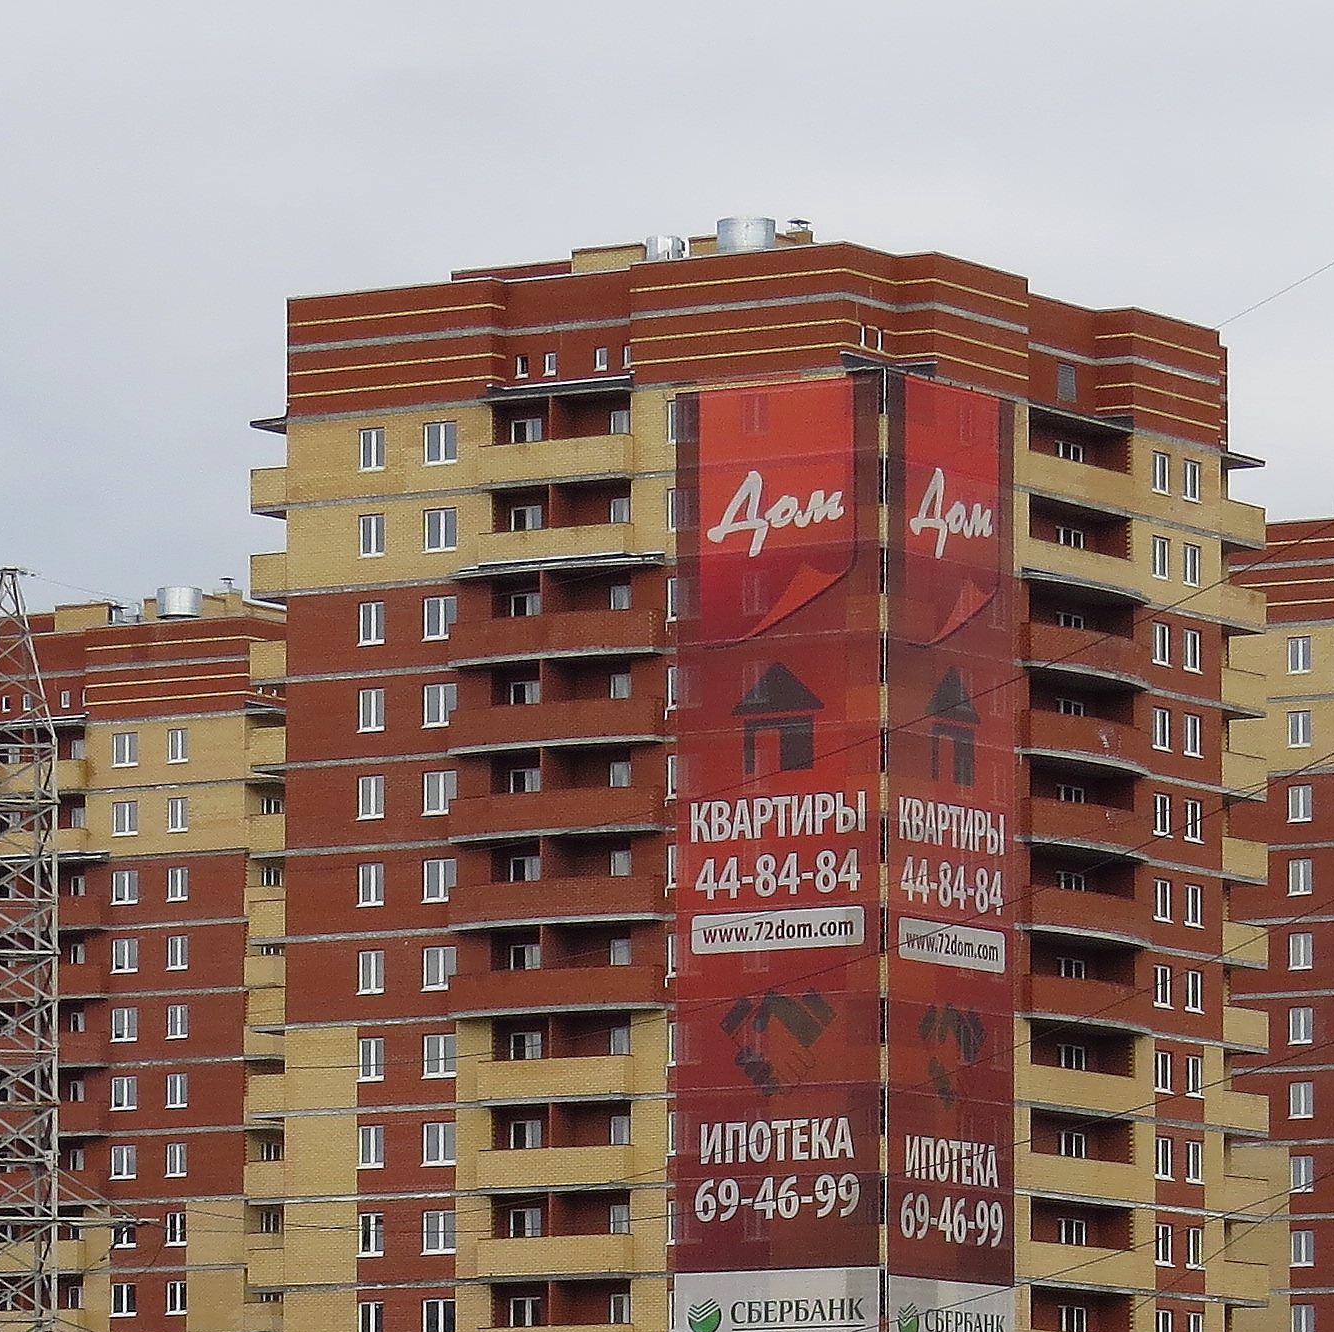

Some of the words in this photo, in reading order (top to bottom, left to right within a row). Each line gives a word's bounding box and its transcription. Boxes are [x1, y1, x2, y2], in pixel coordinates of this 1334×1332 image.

[707, 470, 845, 558] Дом
[909, 467, 993, 560] Дом
[690, 790, 866, 843] КВАРТИРЫ
[898, 796, 1005, 856] КВАРТИРЫ
[695, 848, 861, 900] 44-84-84
[900, 856, 1004, 916] 44-84-84
[702, 919, 854, 944] www.72dom.com
[906, 932, 999, 962] www.72dom.com
[699, 1116, 855, 1165] ИПОТЕКА
[905, 1134, 999, 1188] ИПОТЕКА
[694, 1173, 860, 1223] 69-46-99
[900, 1192, 1003, 1247] 69-46-99
[730, 1298, 866, 1324] СБЕРБАНК
